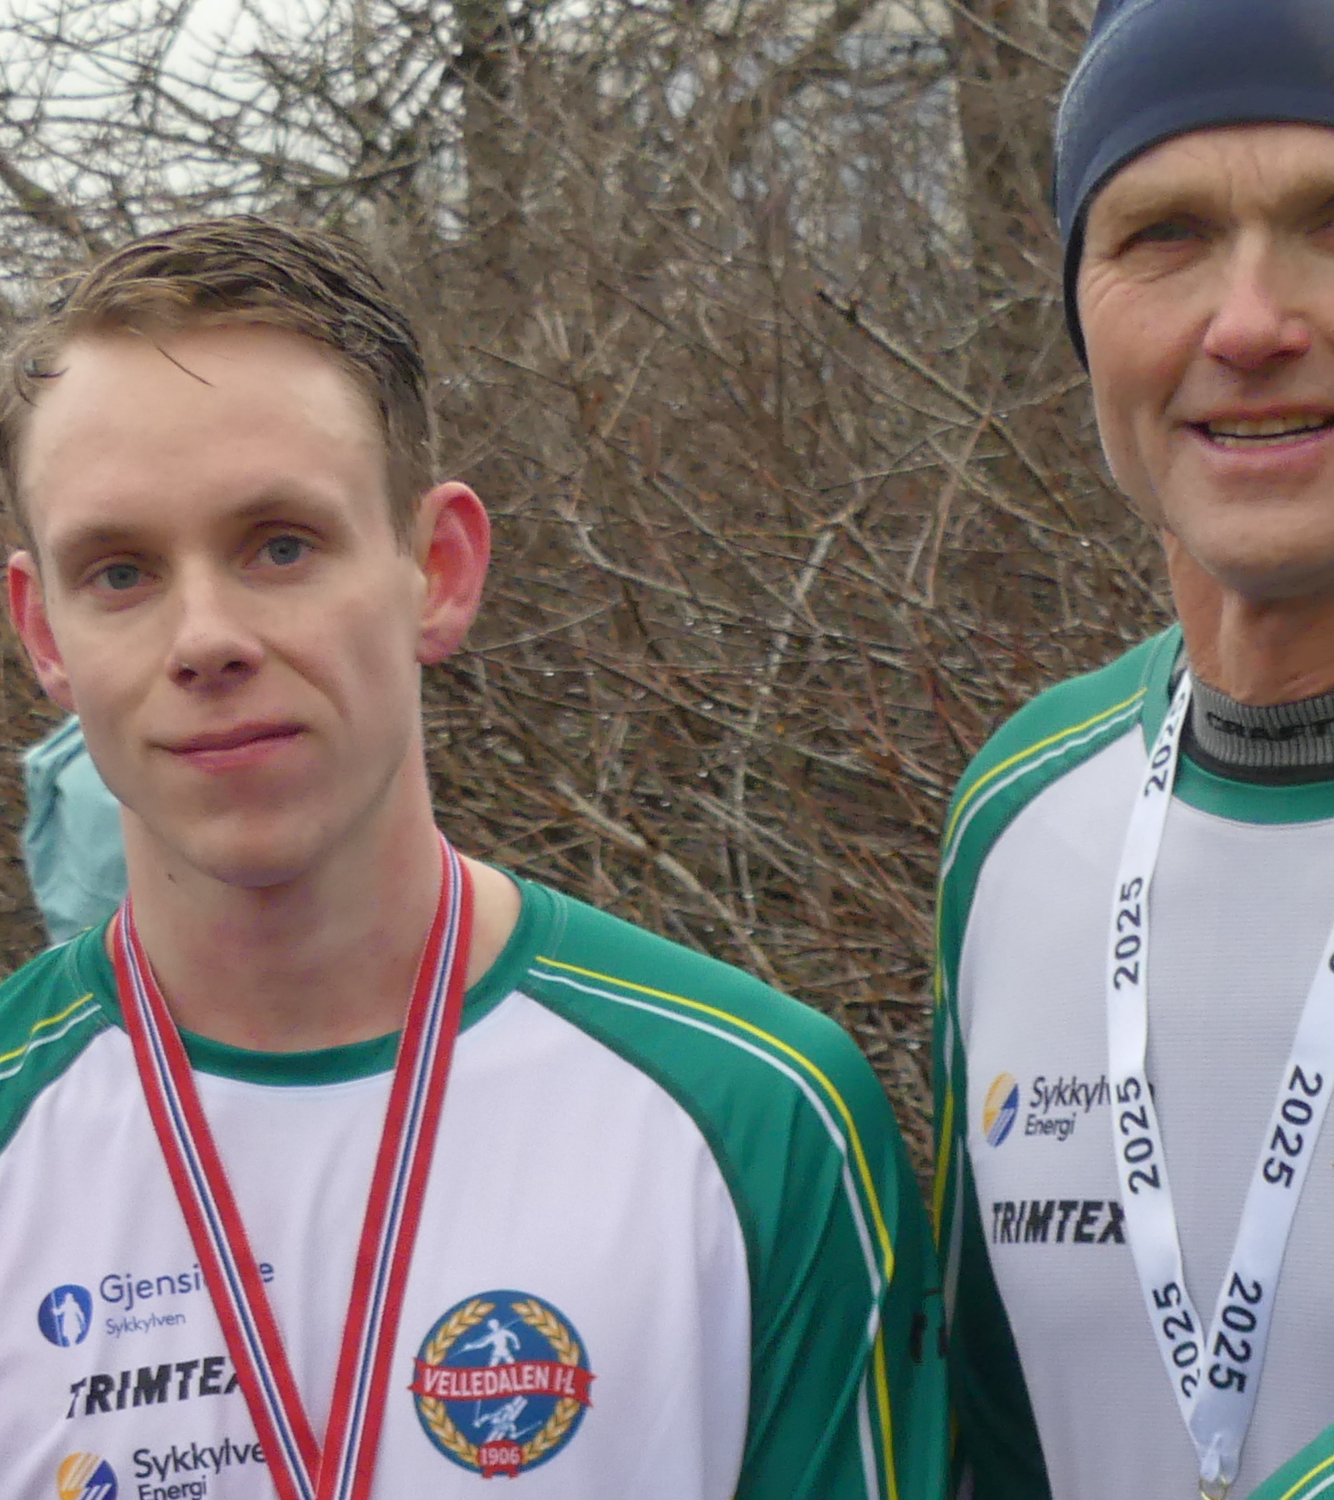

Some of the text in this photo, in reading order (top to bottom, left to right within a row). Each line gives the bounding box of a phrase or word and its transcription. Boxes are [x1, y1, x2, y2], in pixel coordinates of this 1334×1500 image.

[1113, 876, 1144, 991] 2025
[1024, 1112, 1076, 1142] Energi
[1116, 1076, 1161, 1195] 2025
[1262, 1065, 1324, 1190] 2025
[992, 1200, 1125, 1244] TRIMTEX
[99, 1262, 275, 1311] Gjensie
[106, 1313, 187, 1338] Sykkylven
[1152, 1282, 1199, 1398] 2025
[1208, 1272, 1262, 1393] 2025
[424, 1365, 550, 1396] VELLEDALEN
[134, 1438, 268, 1482] Sykkylve
[480, 1447, 521, 1466] 1906
